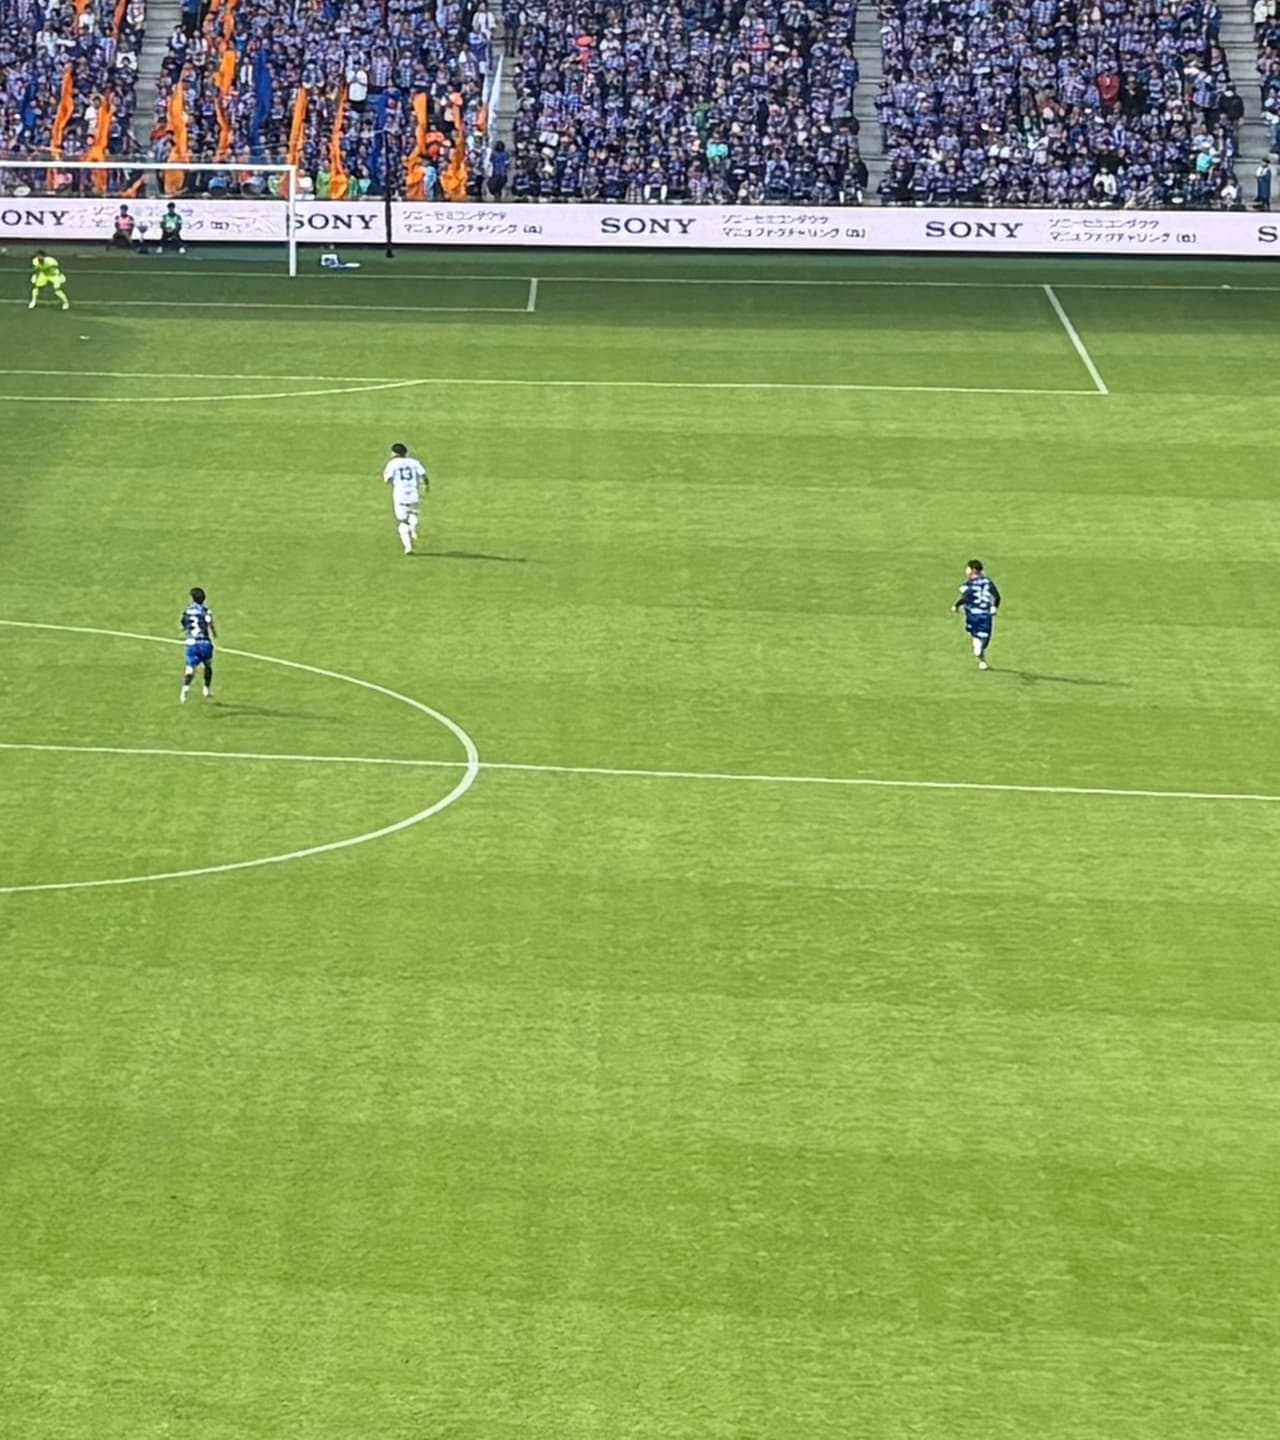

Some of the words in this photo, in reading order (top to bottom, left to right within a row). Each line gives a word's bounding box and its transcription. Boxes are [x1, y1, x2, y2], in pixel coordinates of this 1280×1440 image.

[293, 214, 378, 230] SONY
[601, 217, 696, 235] SONY
[925, 221, 1024, 239] SONY
[399, 466, 412, 481] 13
